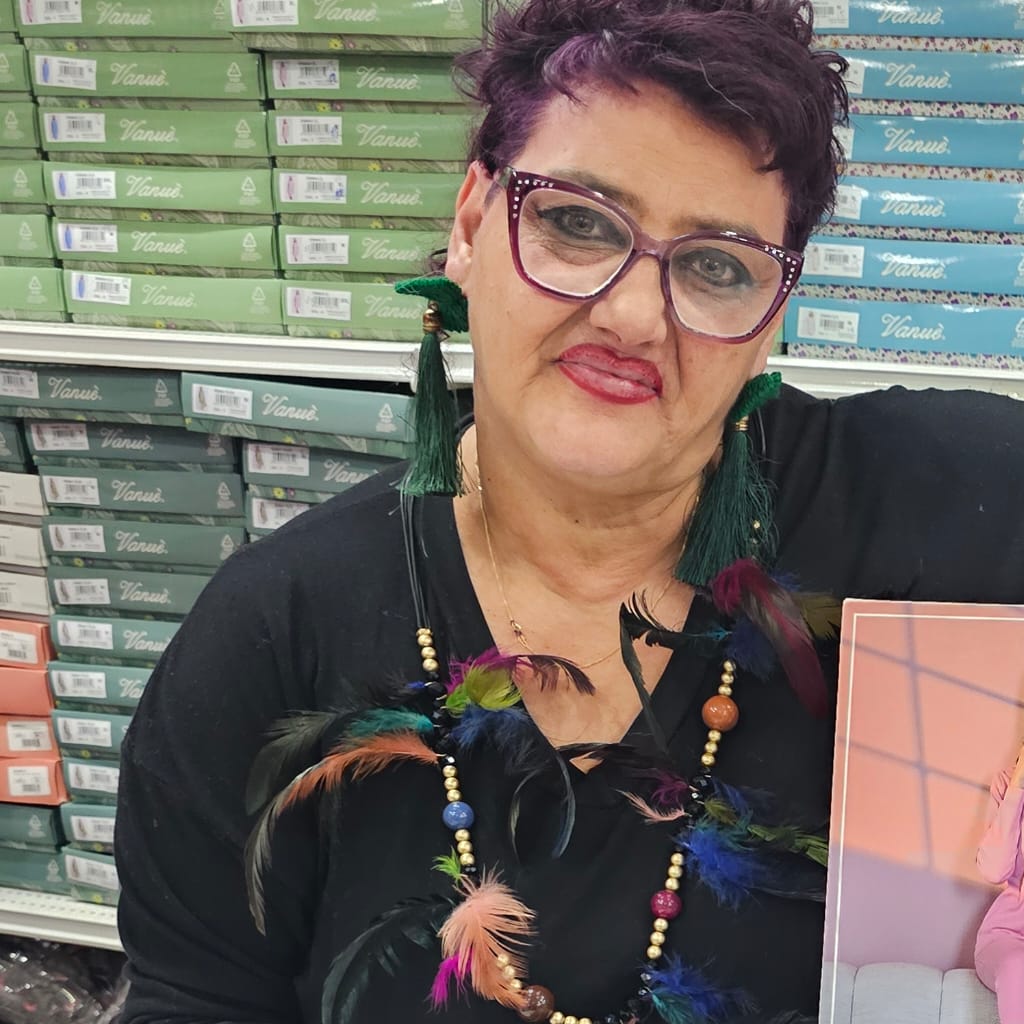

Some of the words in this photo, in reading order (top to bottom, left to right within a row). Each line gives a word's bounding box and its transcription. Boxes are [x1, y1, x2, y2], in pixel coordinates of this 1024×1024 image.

[97, 3, 152, 25] Vanuè
[110, 63, 169, 87] Vanuè
[356, 67, 420, 90] Vanuè
[886, 63, 951, 89] Vanuè
[119, 119, 179, 142] Vanuè
[357, 123, 422, 147] Vanuè
[884, 127, 950, 155] Vanuè
[126, 176, 184, 199] Vanuè
[360, 181, 423, 206] Vanuè
[879, 192, 947, 218] Vanuè
[131, 231, 188, 254] Vanuè
[361, 238, 422, 262] Vanuè
[880, 253, 947, 280] Vanuè
[142, 285, 197, 307] Vanuè
[880, 314, 946, 341] Vanuè
[48, 378, 102, 401] Vanuè
[262, 394, 319, 422] Vanuè
[100, 428, 154, 451] Vanuè
[324, 459, 369, 483] Van
[111, 479, 165, 504] Vanuè
[115, 530, 168, 555] Vanuè
[119, 580, 171, 605] Vanuè
[123, 630, 170, 652] Vanu
